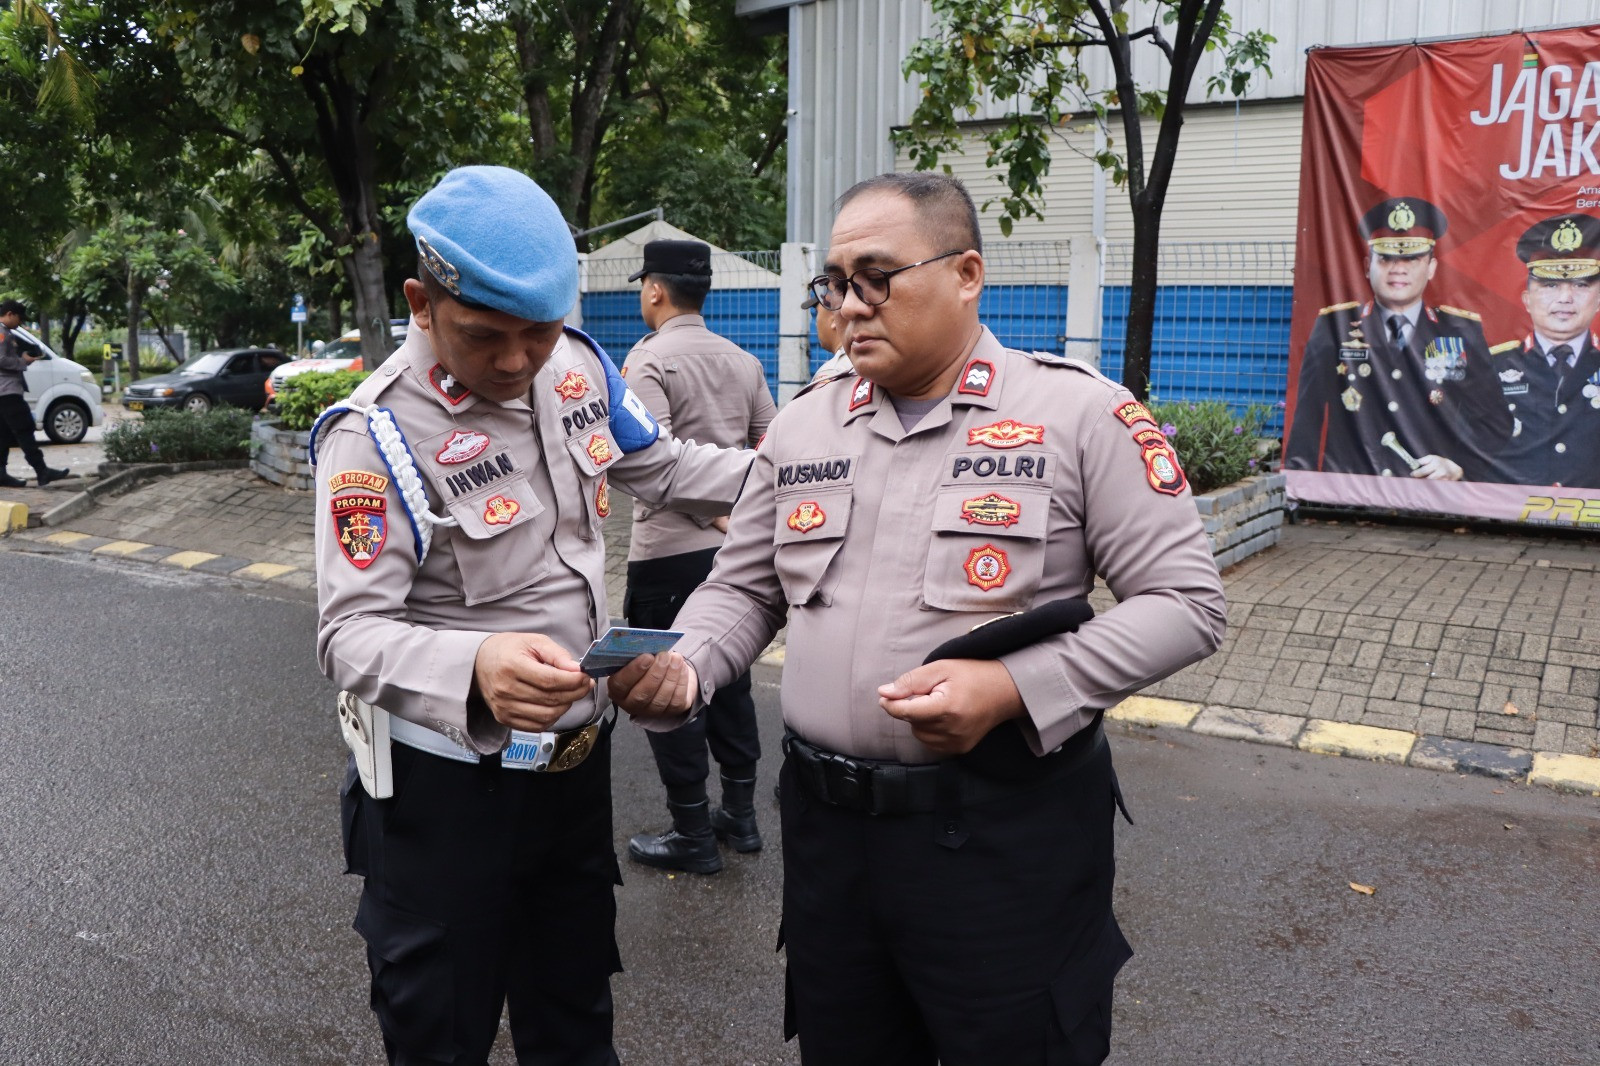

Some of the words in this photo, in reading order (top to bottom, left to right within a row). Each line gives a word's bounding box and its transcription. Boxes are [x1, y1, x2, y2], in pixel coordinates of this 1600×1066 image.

[1470, 61, 1600, 126] JAGA
[1499, 120, 1600, 180] JAK
[562, 398, 609, 436] POLRI
[622, 388, 654, 434] P
[345, 473, 384, 490] PROPAM
[446, 452, 513, 497] IHWAN
[778, 458, 851, 488] KUSNADI
[953, 455, 1046, 479] POLRI
[336, 498, 381, 509] PROPAM
